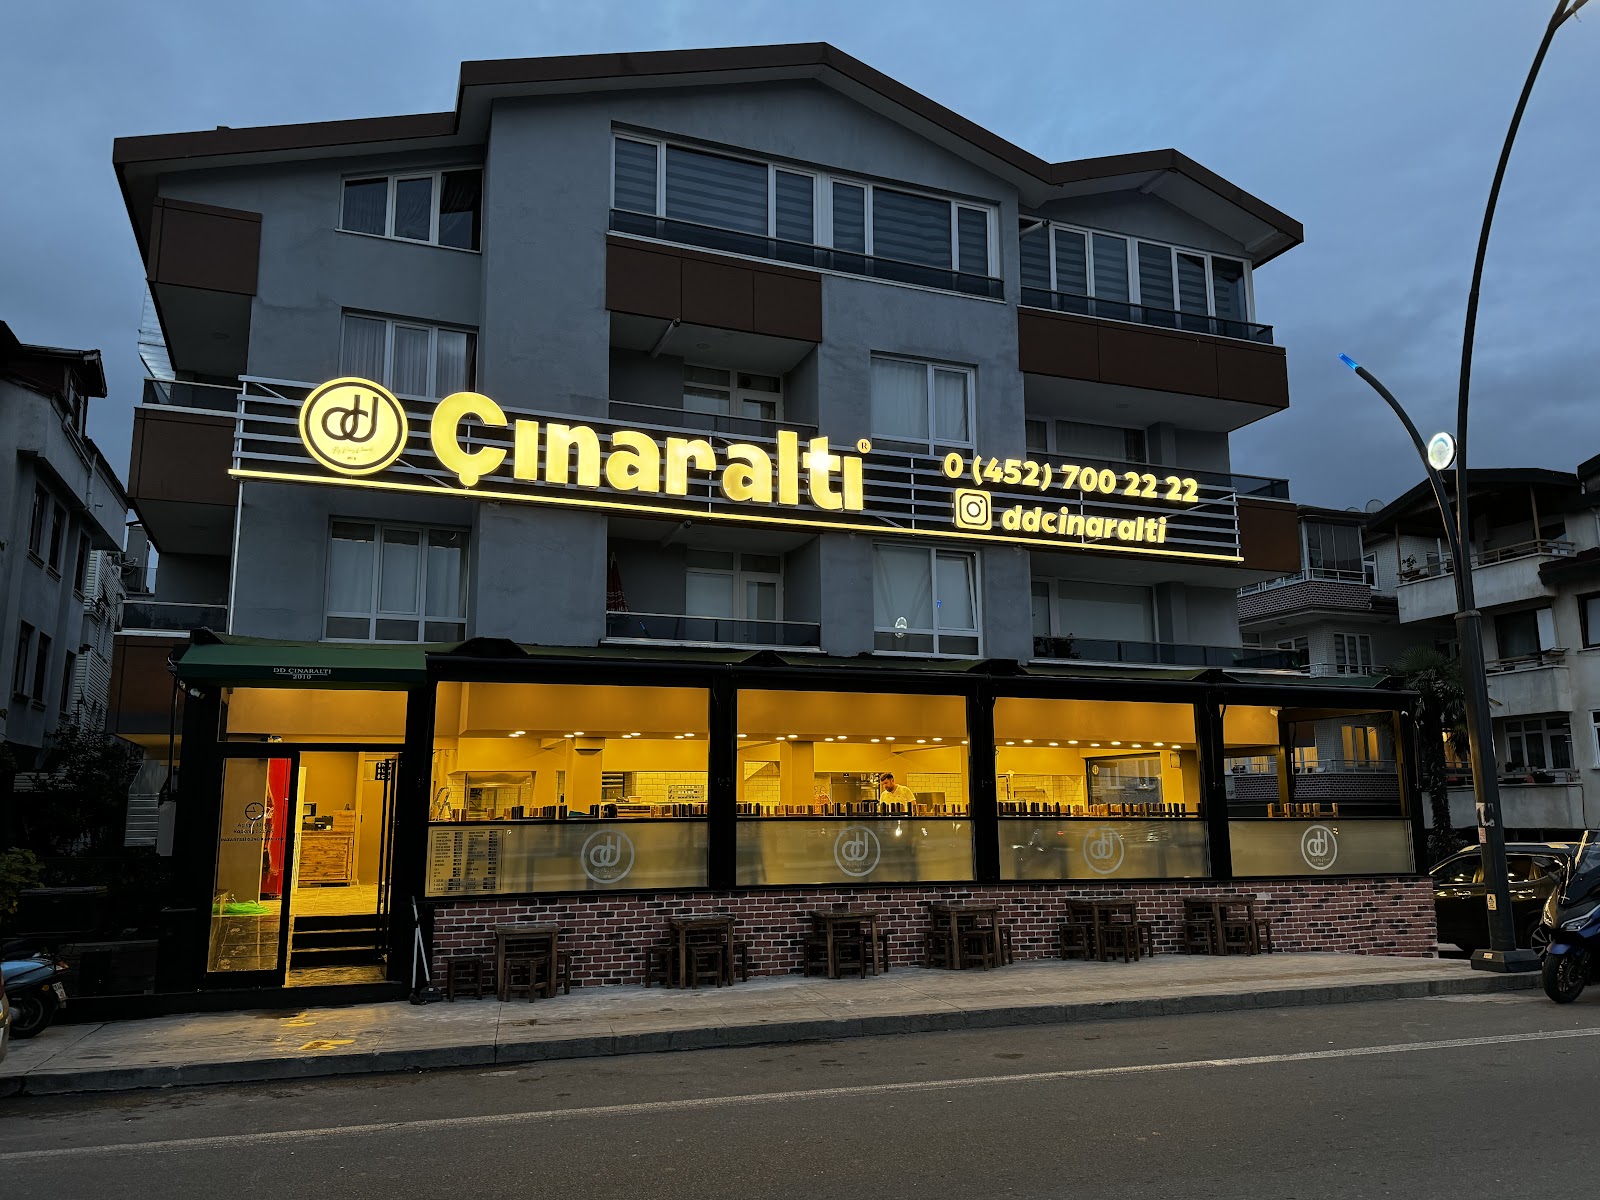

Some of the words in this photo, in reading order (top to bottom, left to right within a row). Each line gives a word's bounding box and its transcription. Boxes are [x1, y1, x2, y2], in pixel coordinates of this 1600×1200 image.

[430, 391, 866, 512] Çınaraltı
[942, 452, 964, 479] 0
[972, 454, 1052, 492] (452)
[1060, 464, 1117, 495] 700
[1122, 471, 1159, 499] 22
[1162, 475, 1200, 503] 22
[1001, 504, 1168, 544] ddcinaralti
